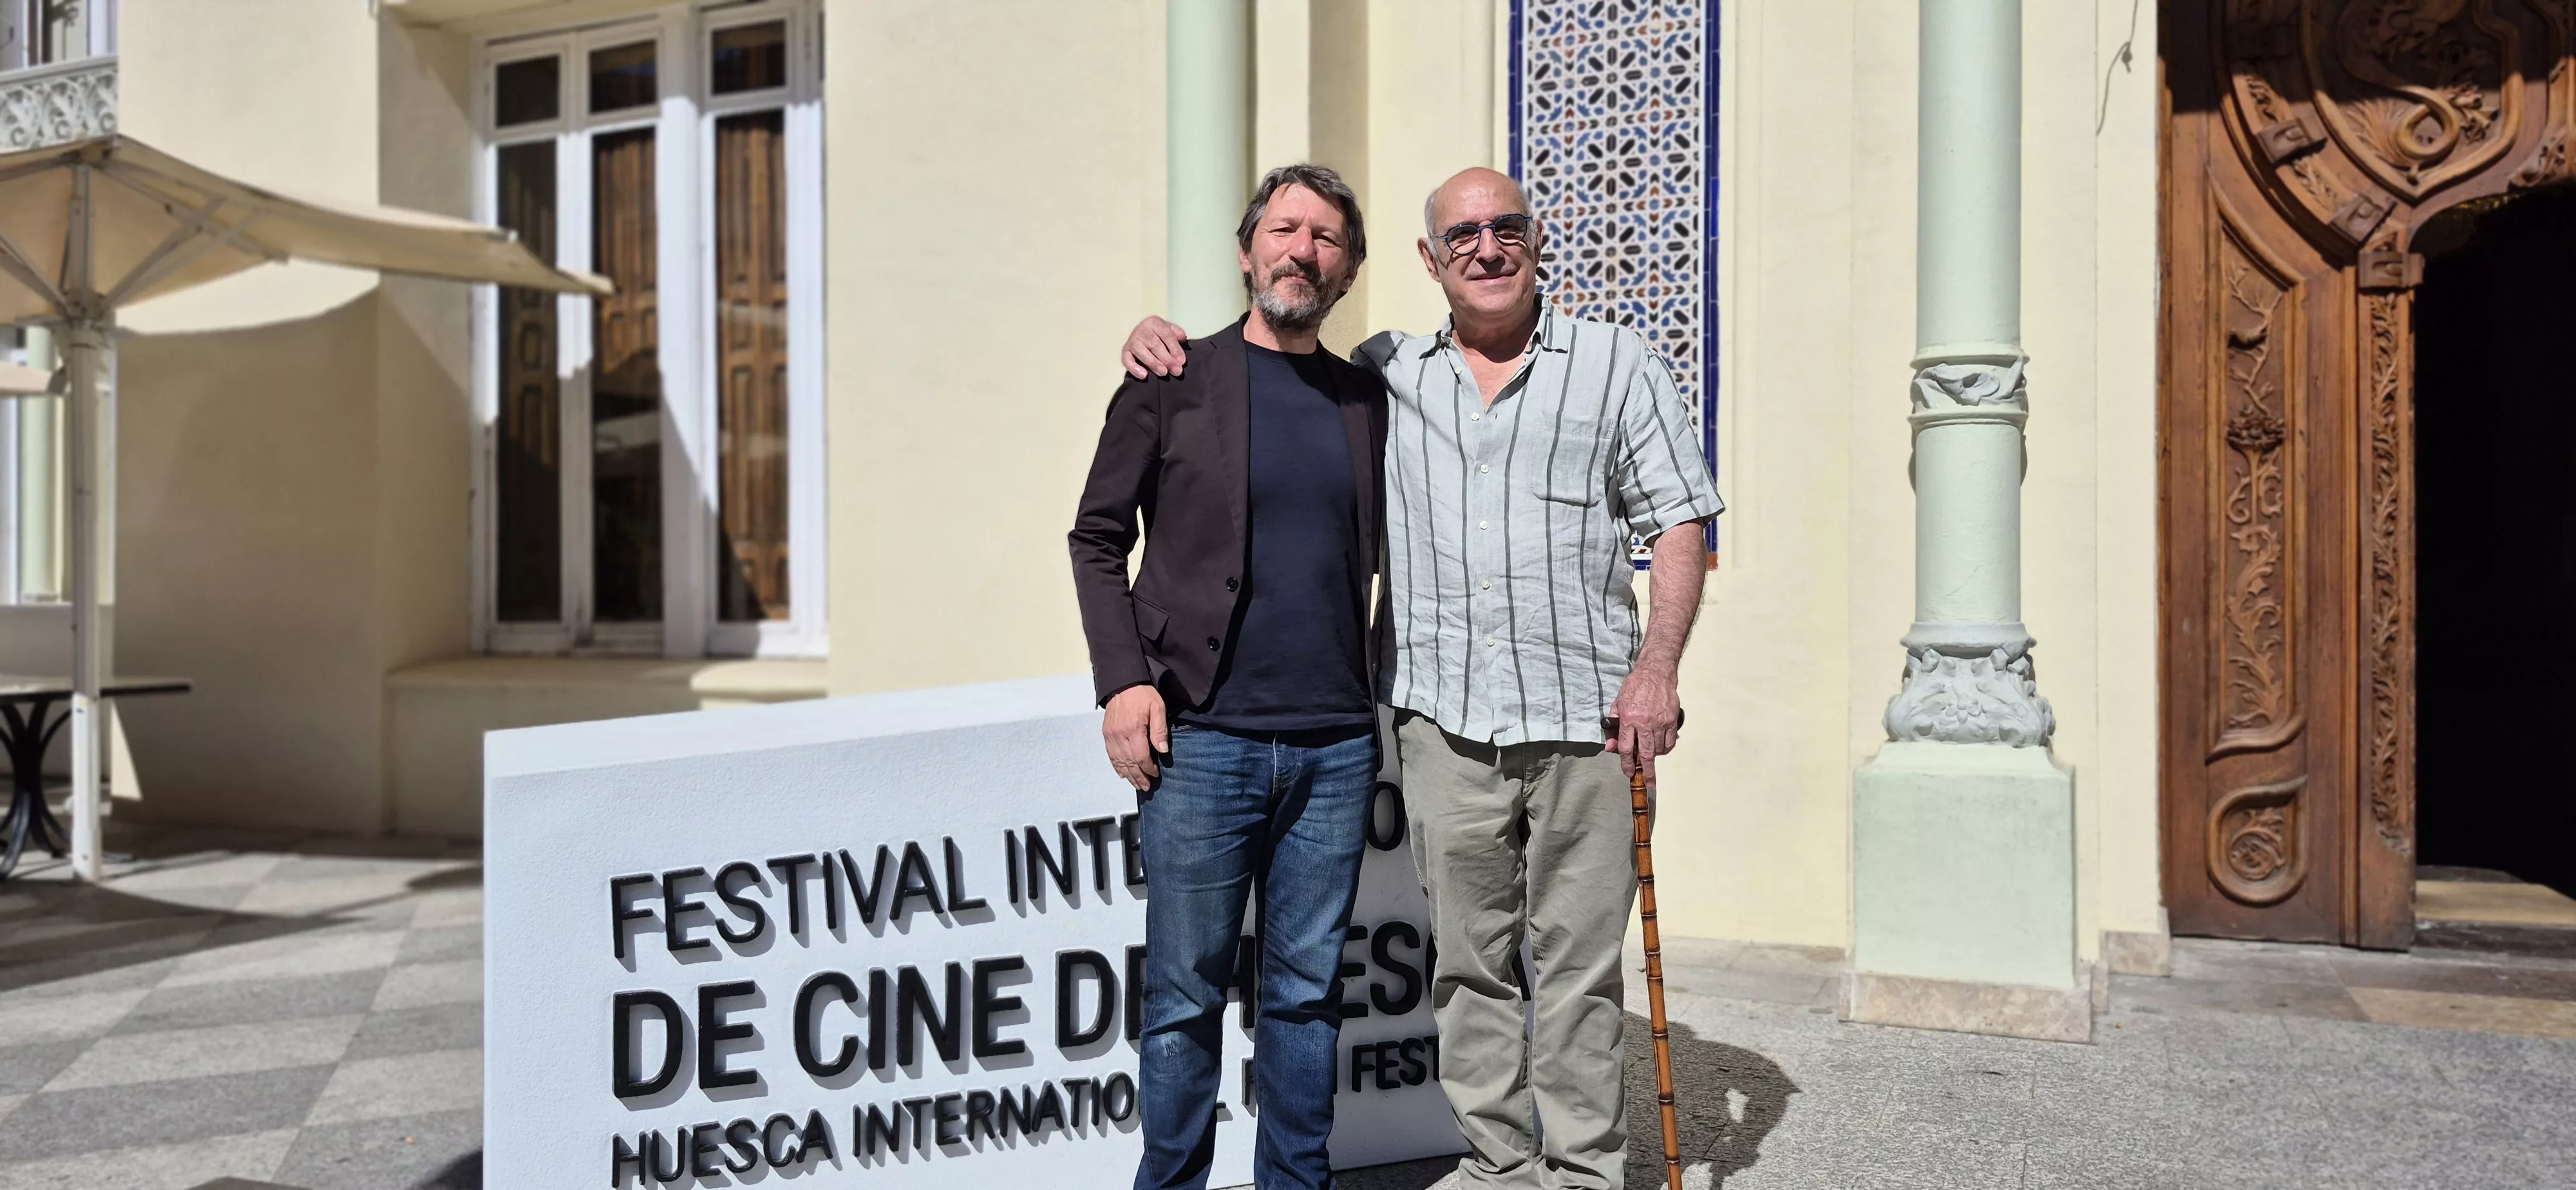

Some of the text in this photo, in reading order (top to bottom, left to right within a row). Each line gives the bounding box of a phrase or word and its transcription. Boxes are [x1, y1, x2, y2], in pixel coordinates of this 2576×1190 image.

[611, 811, 1146, 959] FESTIVAL INTE
[612, 979, 758, 1099] DE
[793, 954, 1026, 1077] CINE
[612, 1108, 833, 1188] HUESCA
[852, 1070, 1135, 1157] INTERNATIO
